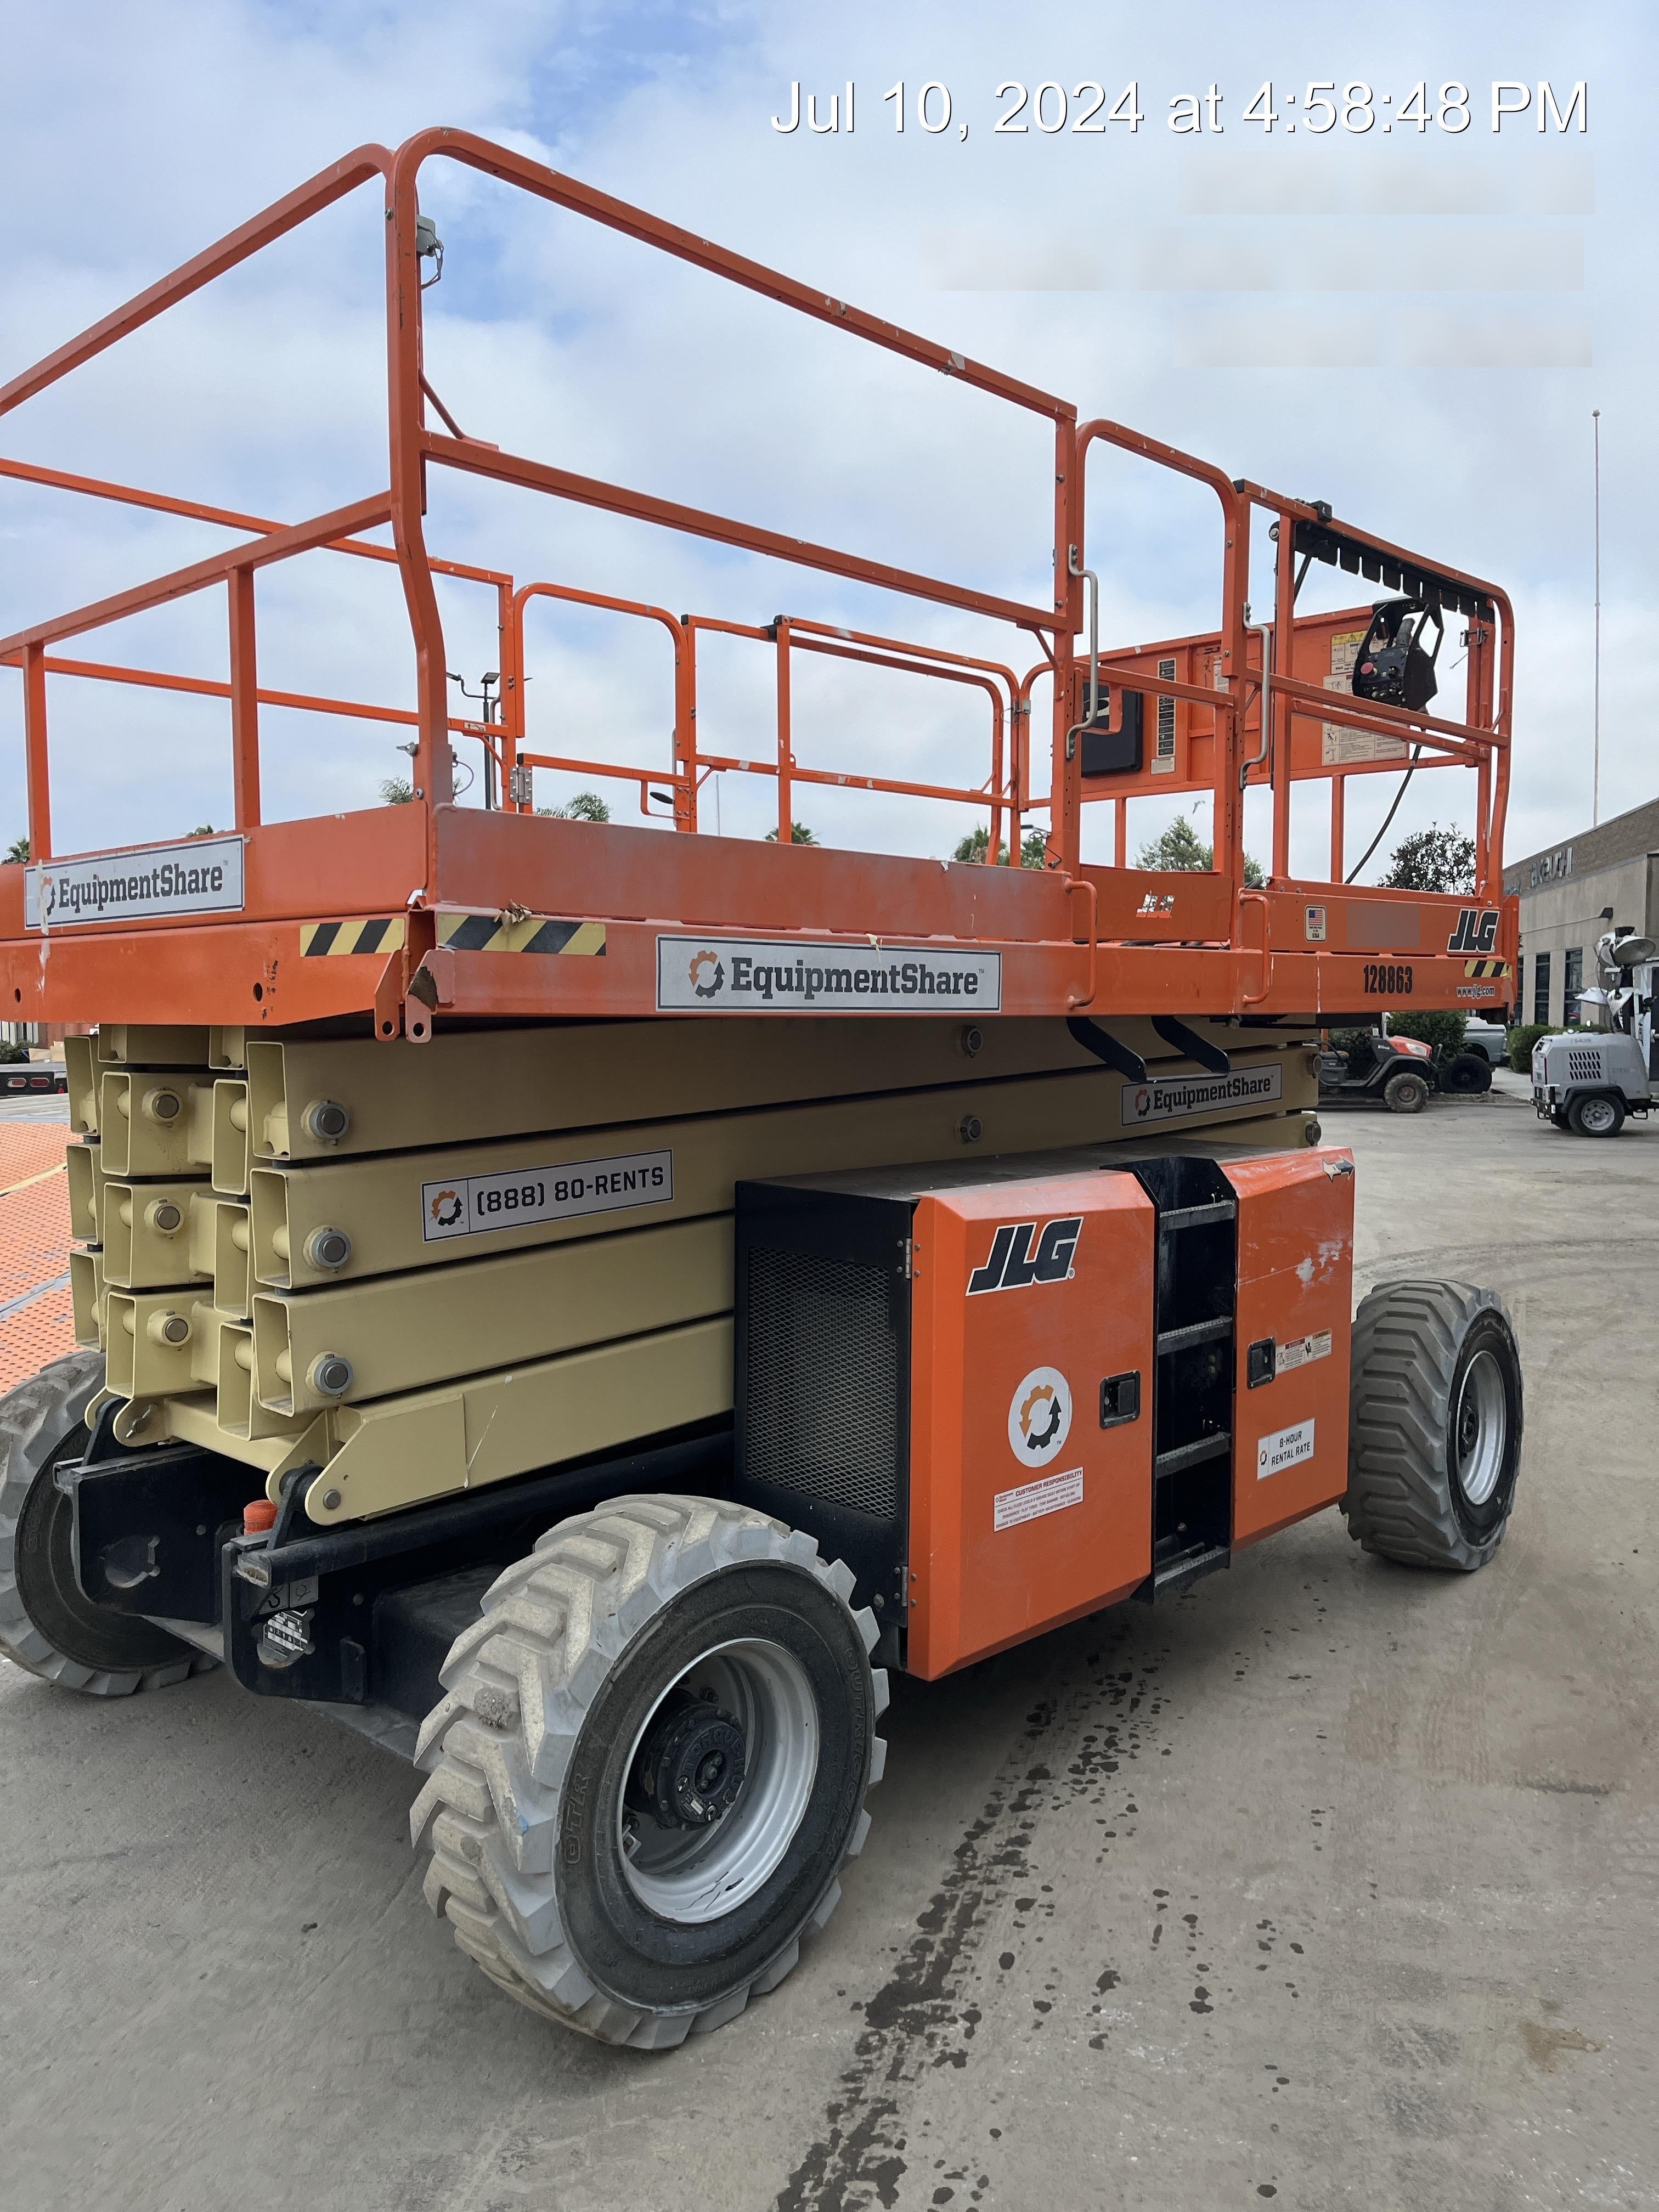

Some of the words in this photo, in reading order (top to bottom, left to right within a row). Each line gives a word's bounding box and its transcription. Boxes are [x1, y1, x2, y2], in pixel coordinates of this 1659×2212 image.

[59, 863, 222, 914] EquipmentShare
[1447, 909, 1500, 952] JLG
[731, 957, 979, 1000] EquipmentShare
[1363, 964, 1413, 994] 128863
[1457, 984, 1494, 999] www.jlg.com
[1153, 1076, 1271, 1113] EquipmentShare
[477, 1182, 545, 1216] (888)
[555, 1166, 664, 1202] 80-RENTS
[966, 1216, 1084, 1296] JLG
[1271, 1449, 1294, 1466] RENTAL
[1295, 1441, 1311, 1457] RATE
[1279, 1430, 1302, 1448] 8-HOUR
[1016, 1483, 1042, 1496] CUSTOMER
[1043, 1470, 1082, 1487] RESPONSIBILITY
